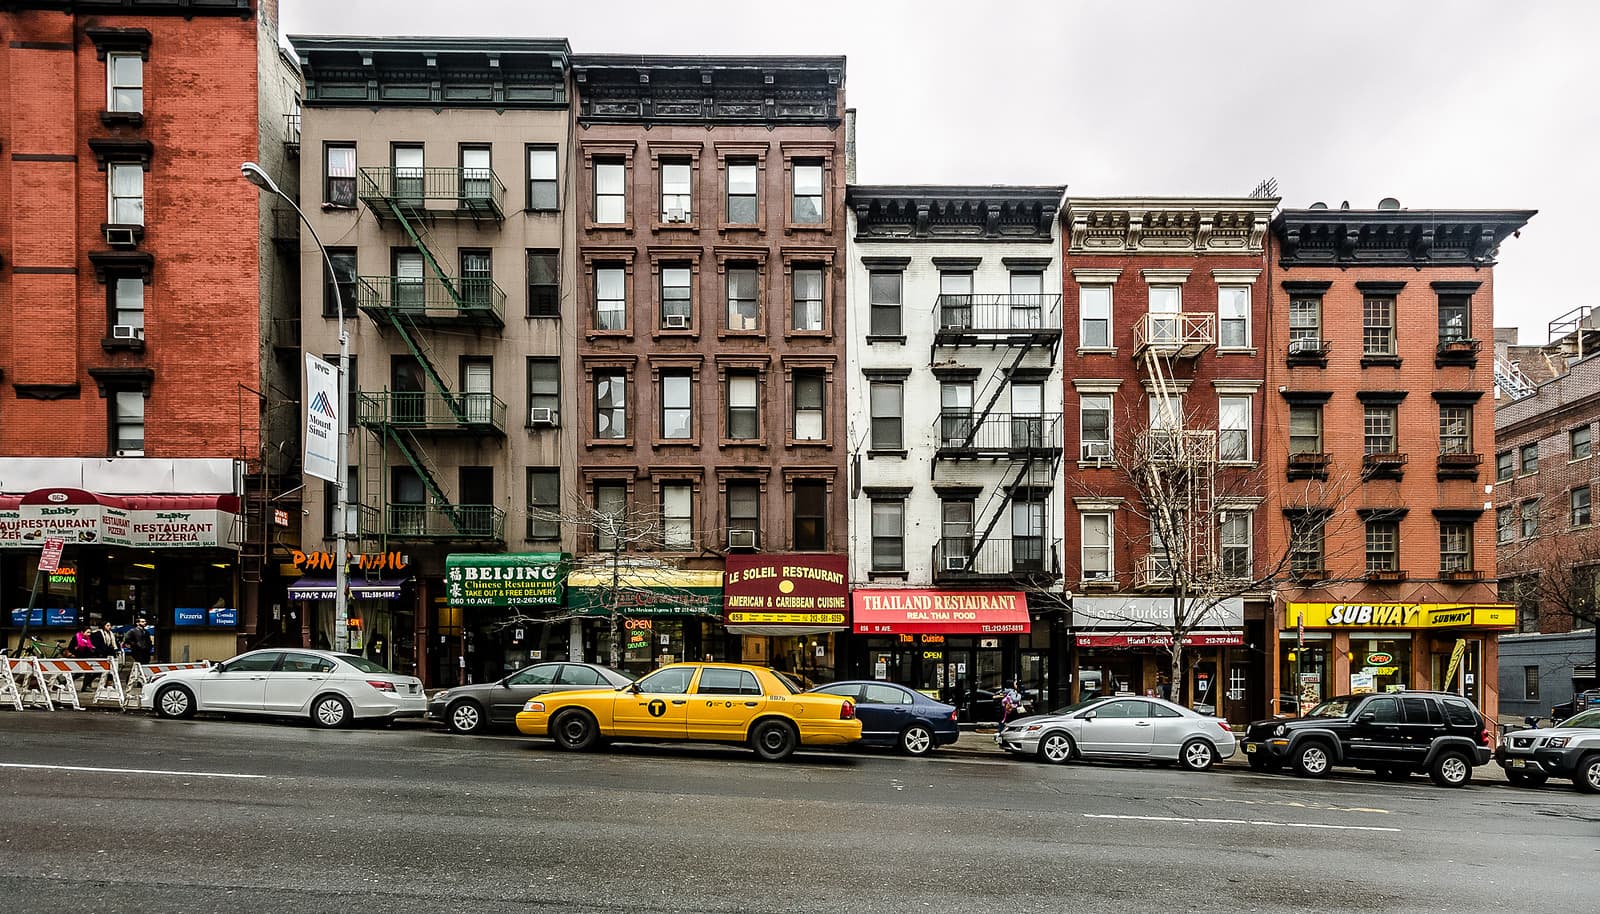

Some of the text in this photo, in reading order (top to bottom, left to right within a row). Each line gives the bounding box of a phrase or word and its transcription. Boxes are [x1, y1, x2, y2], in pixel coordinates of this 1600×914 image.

[314, 361, 330, 376] NYC
[309, 414, 332, 431] Mount
[308, 424, 327, 439] Sinai
[40, 507, 80, 516] Rubby
[20, 519, 97, 528] RESTAURANT
[102, 515, 130, 528] RESTAURANT
[108, 526, 127, 537] PIZZERIA
[133, 523, 213, 533] RESTAURANT
[148, 533, 198, 542] PIZZERIA
[291, 550, 407, 570] PAN NAIL
[464, 566, 557, 580] BEIJING
[729, 566, 844, 585] LE SOLEIL RESTAURANT
[49, 575, 76, 583] HISPANA
[464, 580, 556, 589] Chinese Restaurant
[294, 591, 320, 600] PAN'S
[465, 589, 483, 597] TAKE
[486, 589, 498, 597] OUT
[505, 589, 523, 597] FREE
[524, 588, 556, 596] DELIVERY
[728, 595, 845, 608] AMERICAN & CARIBBEAN CUISINE
[863, 595, 1016, 610] THAILAND RESTAURANT
[179, 612, 203, 620] Pizzeria
[906, 612, 976, 620] REAL THAI FOOD
[1327, 605, 1421, 625] SUBWAY
[1431, 611, 1471, 625] SUBWAY
[624, 619, 652, 630] OPEN
[898, 633, 945, 643] Thai Cuisine
[923, 651, 943, 659] OPEN
